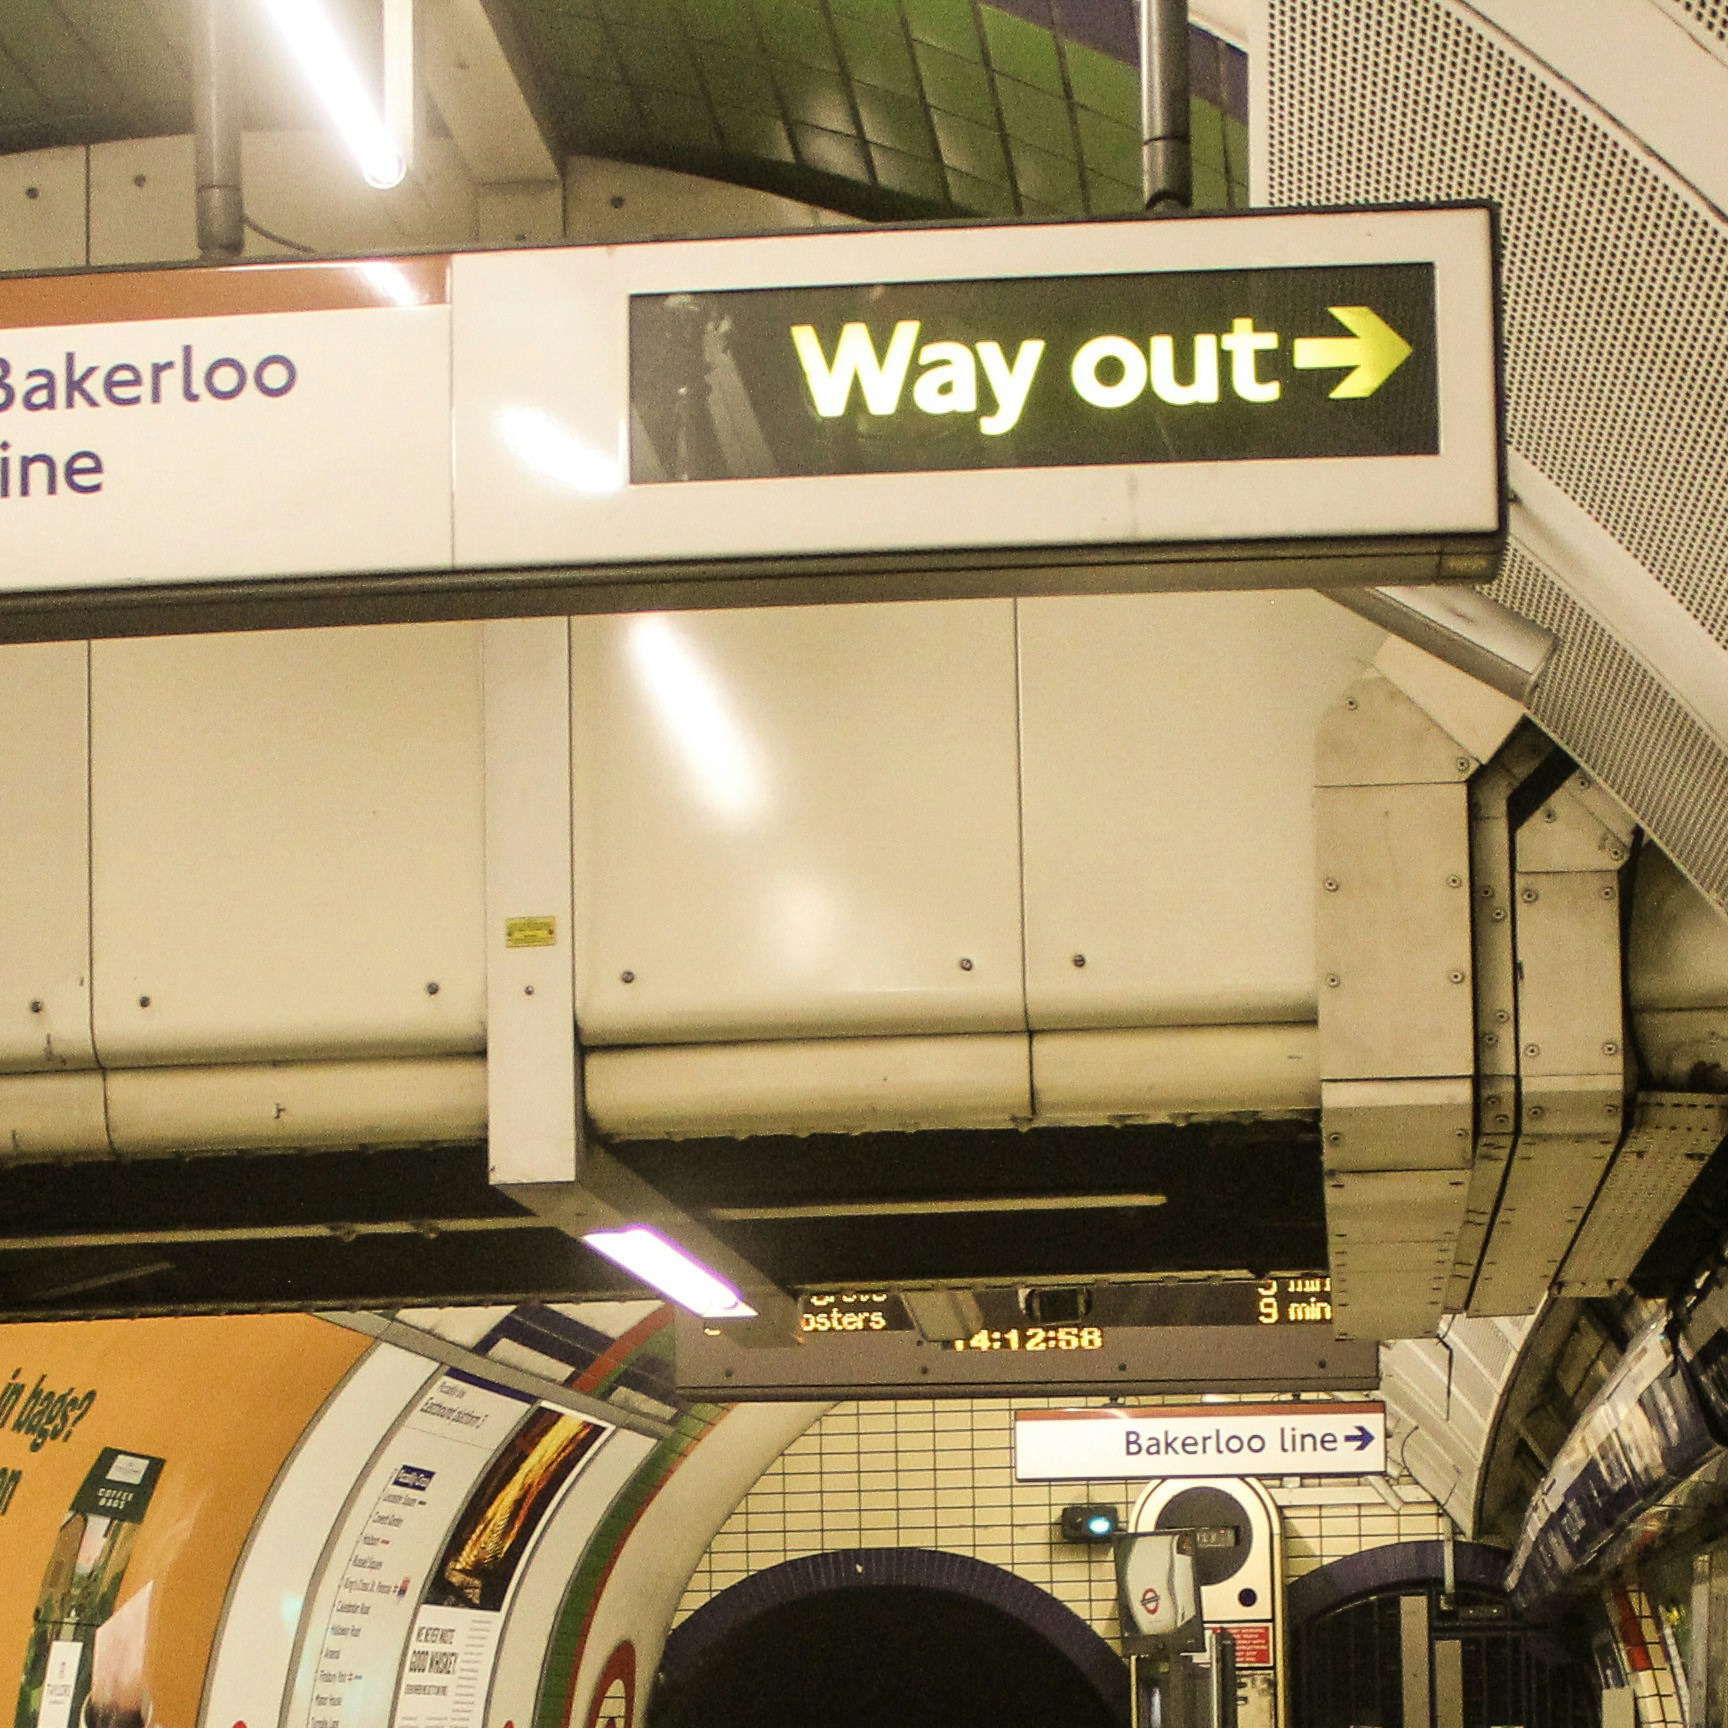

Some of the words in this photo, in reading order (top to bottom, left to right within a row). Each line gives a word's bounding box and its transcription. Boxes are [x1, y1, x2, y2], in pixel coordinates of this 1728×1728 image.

[790, 319, 1046, 437] Way
[1073, 314, 1282, 408] out
[800, 1308, 887, 1332] osters
[1258, 1297, 1279, 1324] 9
[16, 1374, 97, 1453] bags?
[1125, 1430, 1266, 1456] Bakerloo
[1280, 1427, 1338, 1452] line
